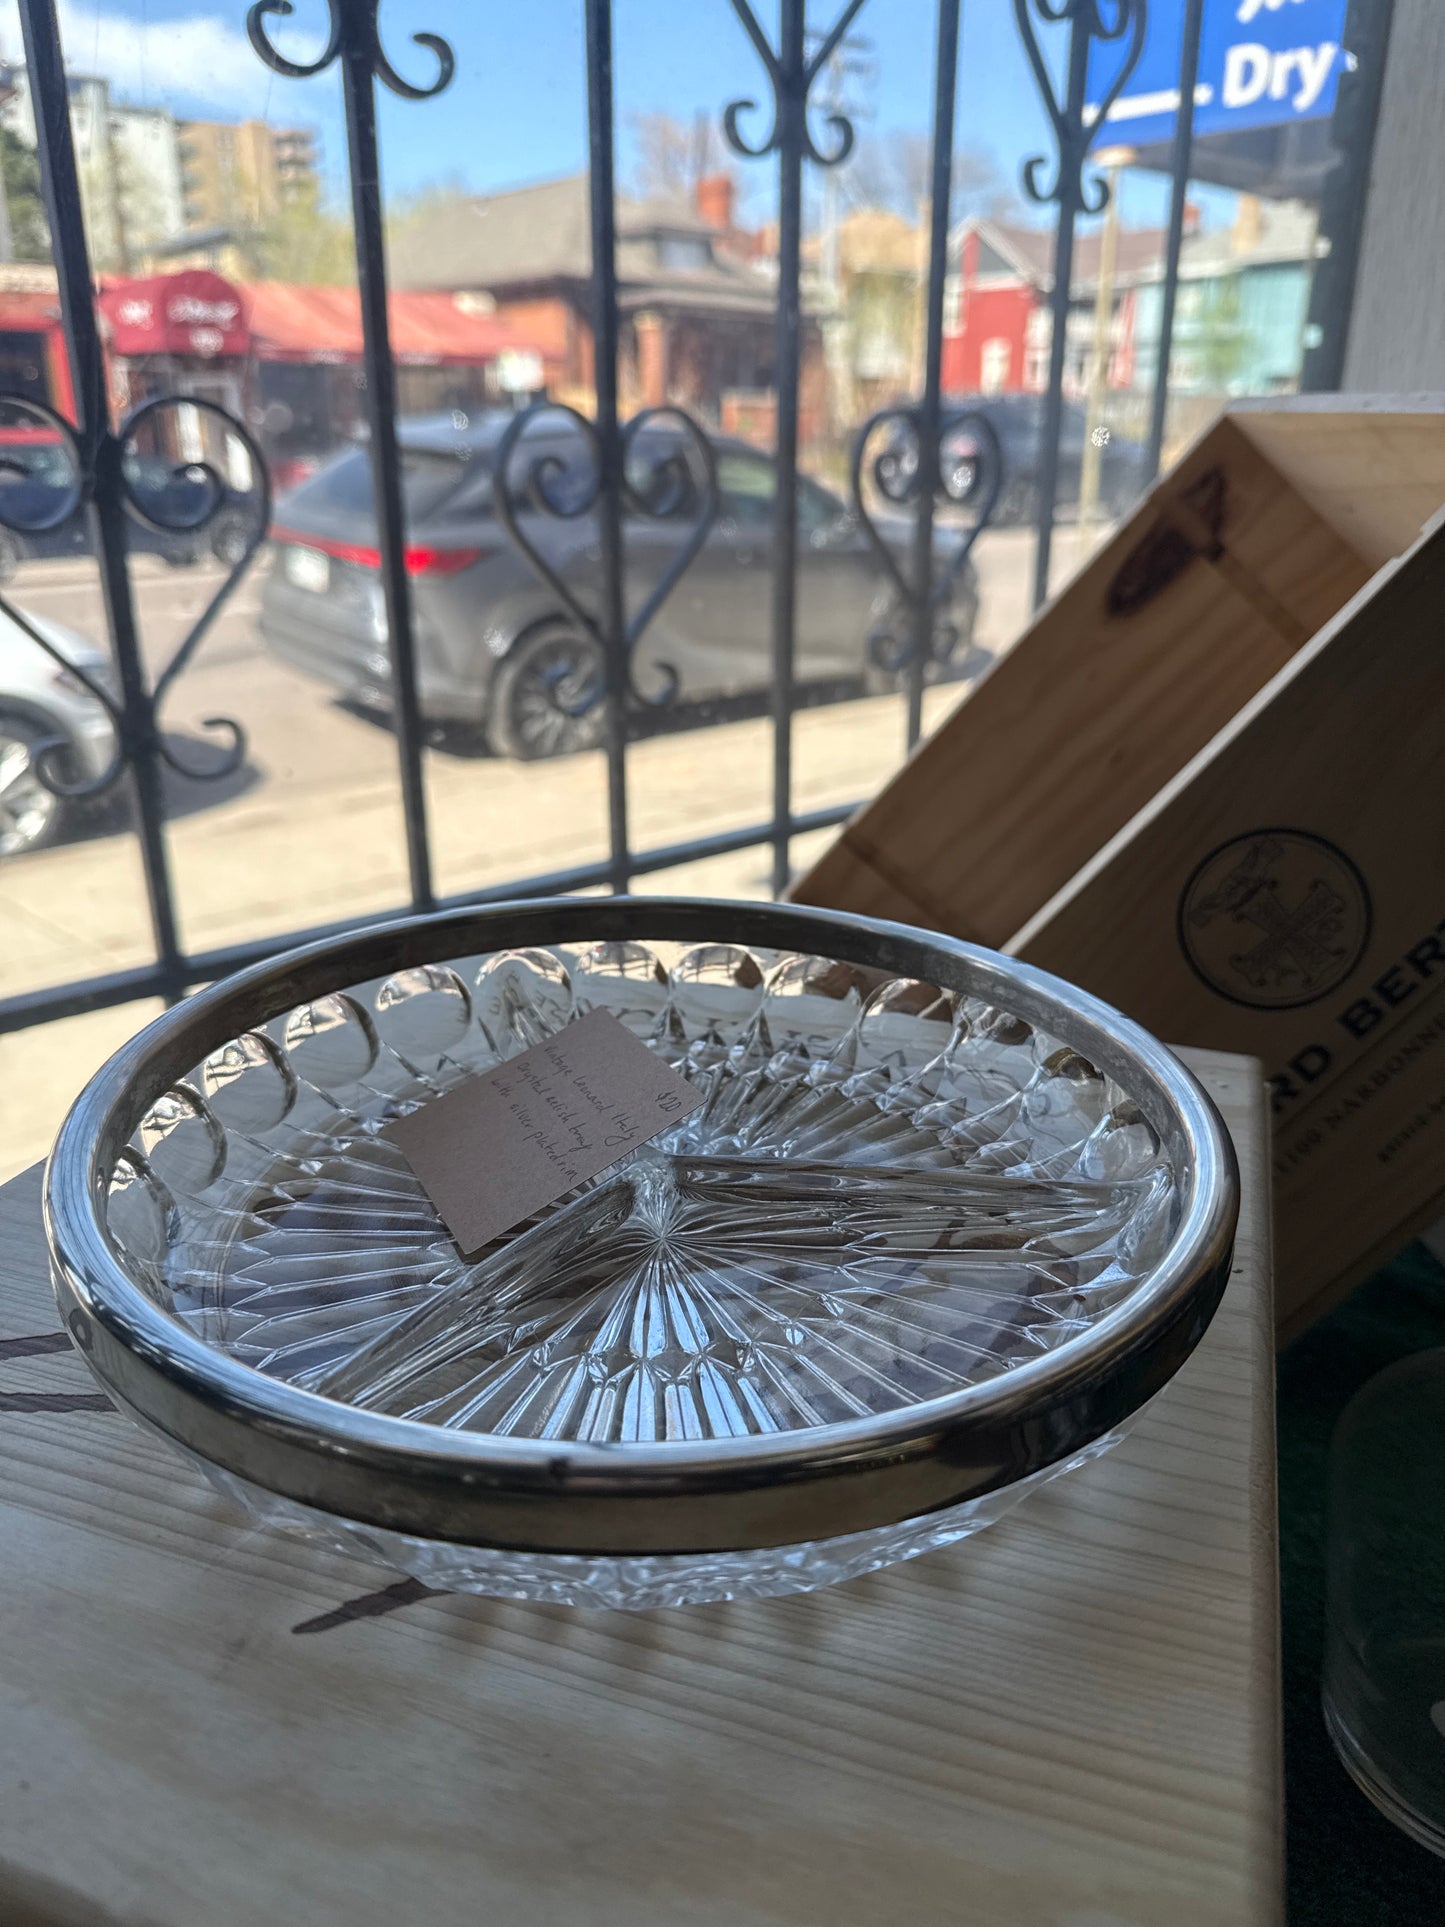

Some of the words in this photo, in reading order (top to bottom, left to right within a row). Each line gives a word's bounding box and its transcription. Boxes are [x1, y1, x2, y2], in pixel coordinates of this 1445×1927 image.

[1223, 41, 1339, 112] Dry
[655, 1091, 682, 1113] $20
[510, 1104, 534, 1129] silver
[522, 1131, 567, 1161] plated
[557, 1160, 578, 1182] rim
[568, 1123, 593, 1153] tray
[604, 1113, 640, 1147] Italy
